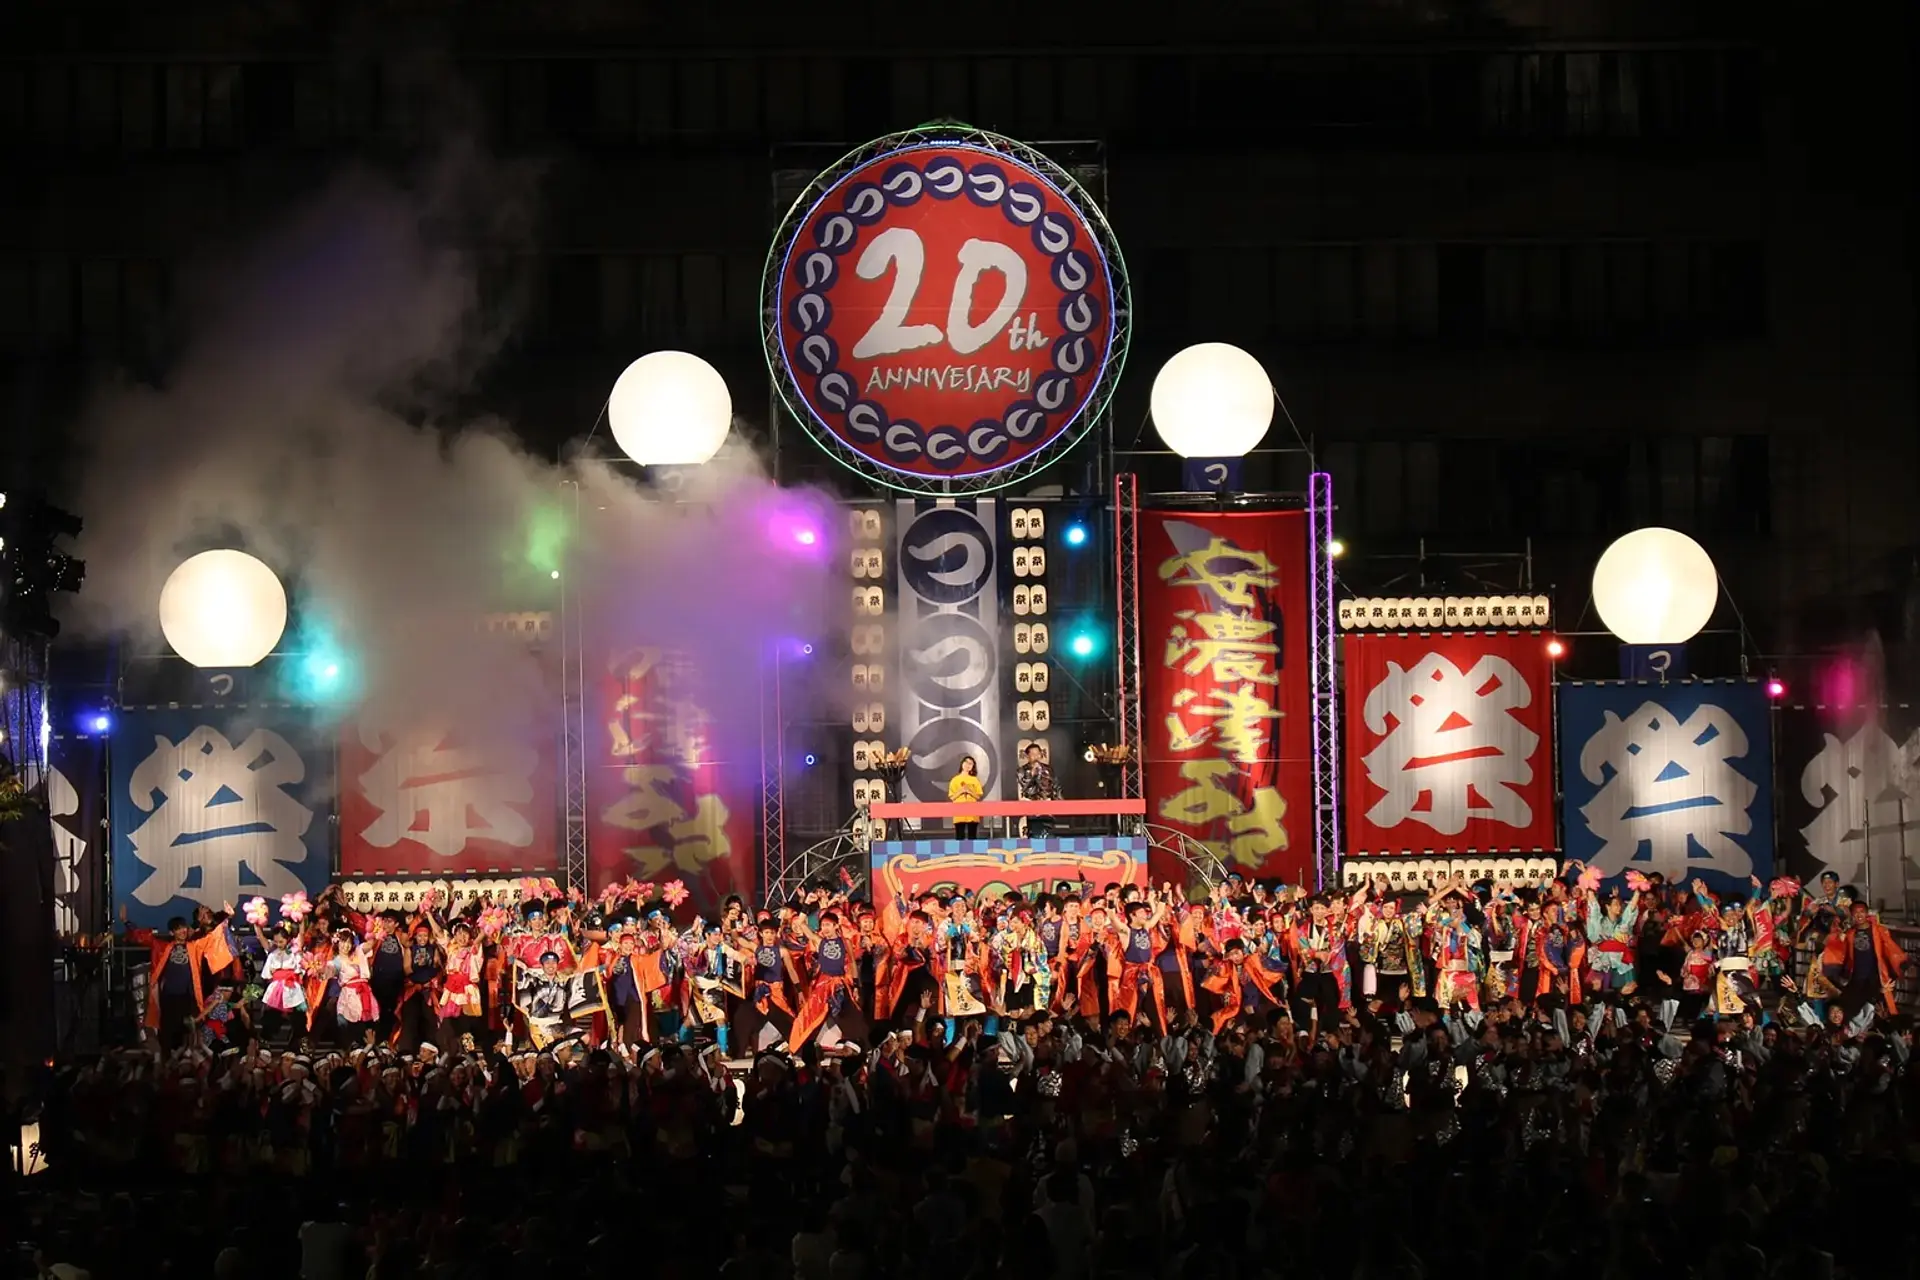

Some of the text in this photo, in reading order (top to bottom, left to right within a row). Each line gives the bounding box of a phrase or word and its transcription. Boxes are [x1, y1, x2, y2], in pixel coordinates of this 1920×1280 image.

[852, 227, 1049, 359] 20th
[864, 365, 1031, 393] ANNIVESARY
[127, 725, 314, 921] 祭
[1360, 652, 1540, 836] 祭
[1579, 700, 1759, 884] 祭
